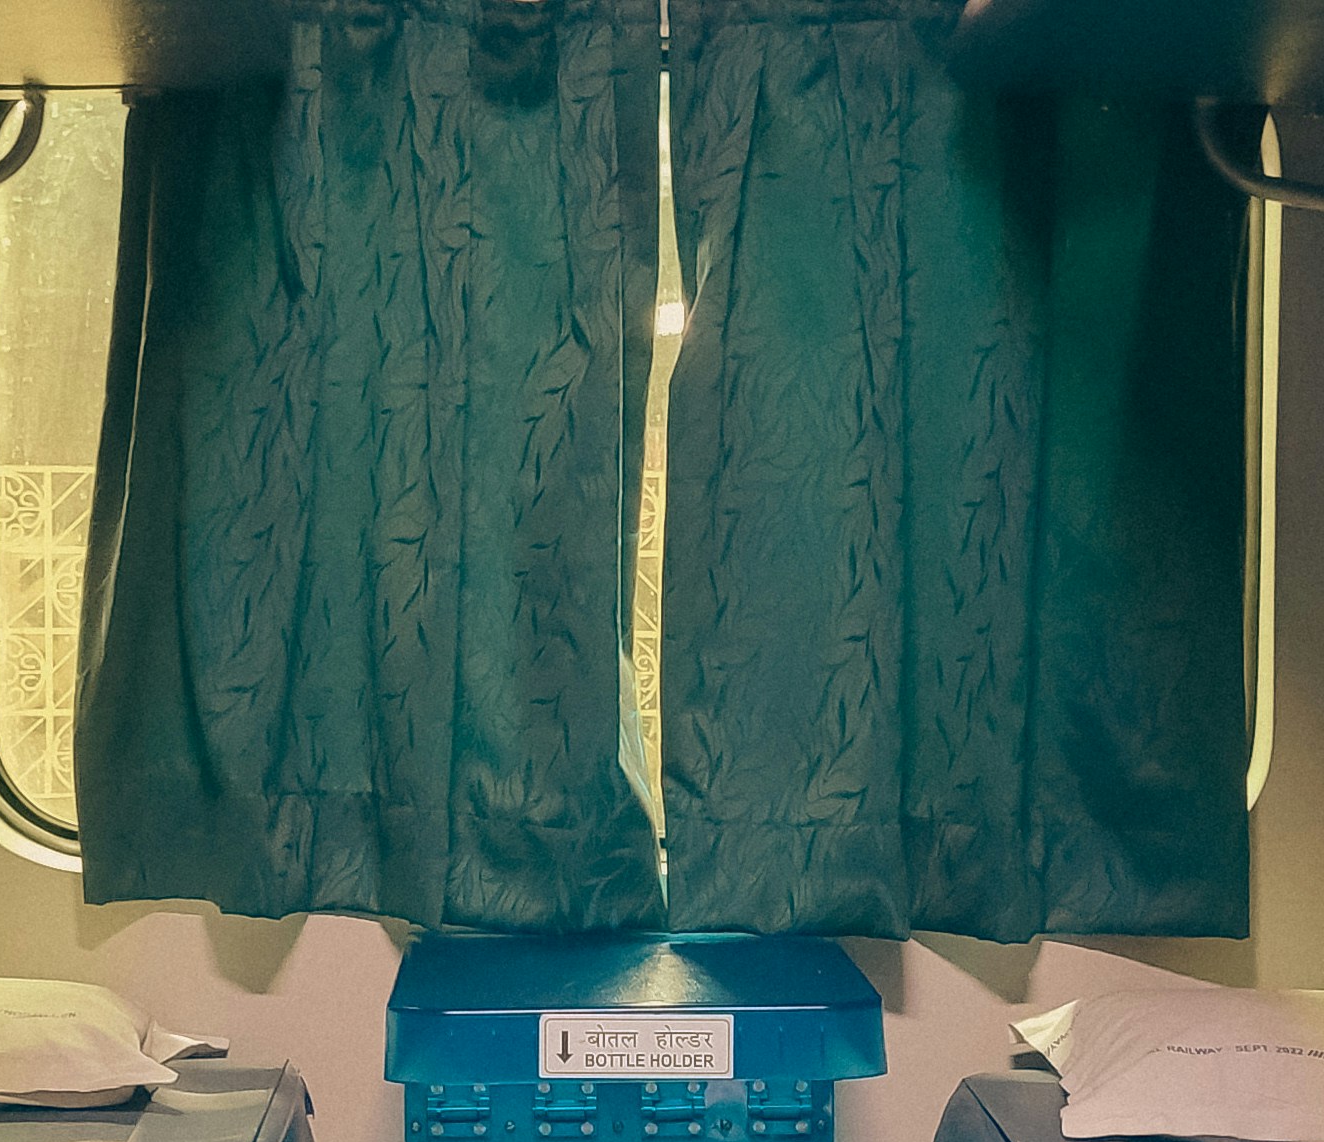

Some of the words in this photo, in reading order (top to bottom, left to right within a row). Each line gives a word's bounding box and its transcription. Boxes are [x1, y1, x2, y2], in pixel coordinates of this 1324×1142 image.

[585, 1024, 638, 1048] बोतल
[654, 1025, 713, 1049] होल्डर
[1167, 1044, 1223, 1055] RAILWAY
[585, 1054, 645, 1067] BOTTLE
[650, 1054, 714, 1067] HOLDER
